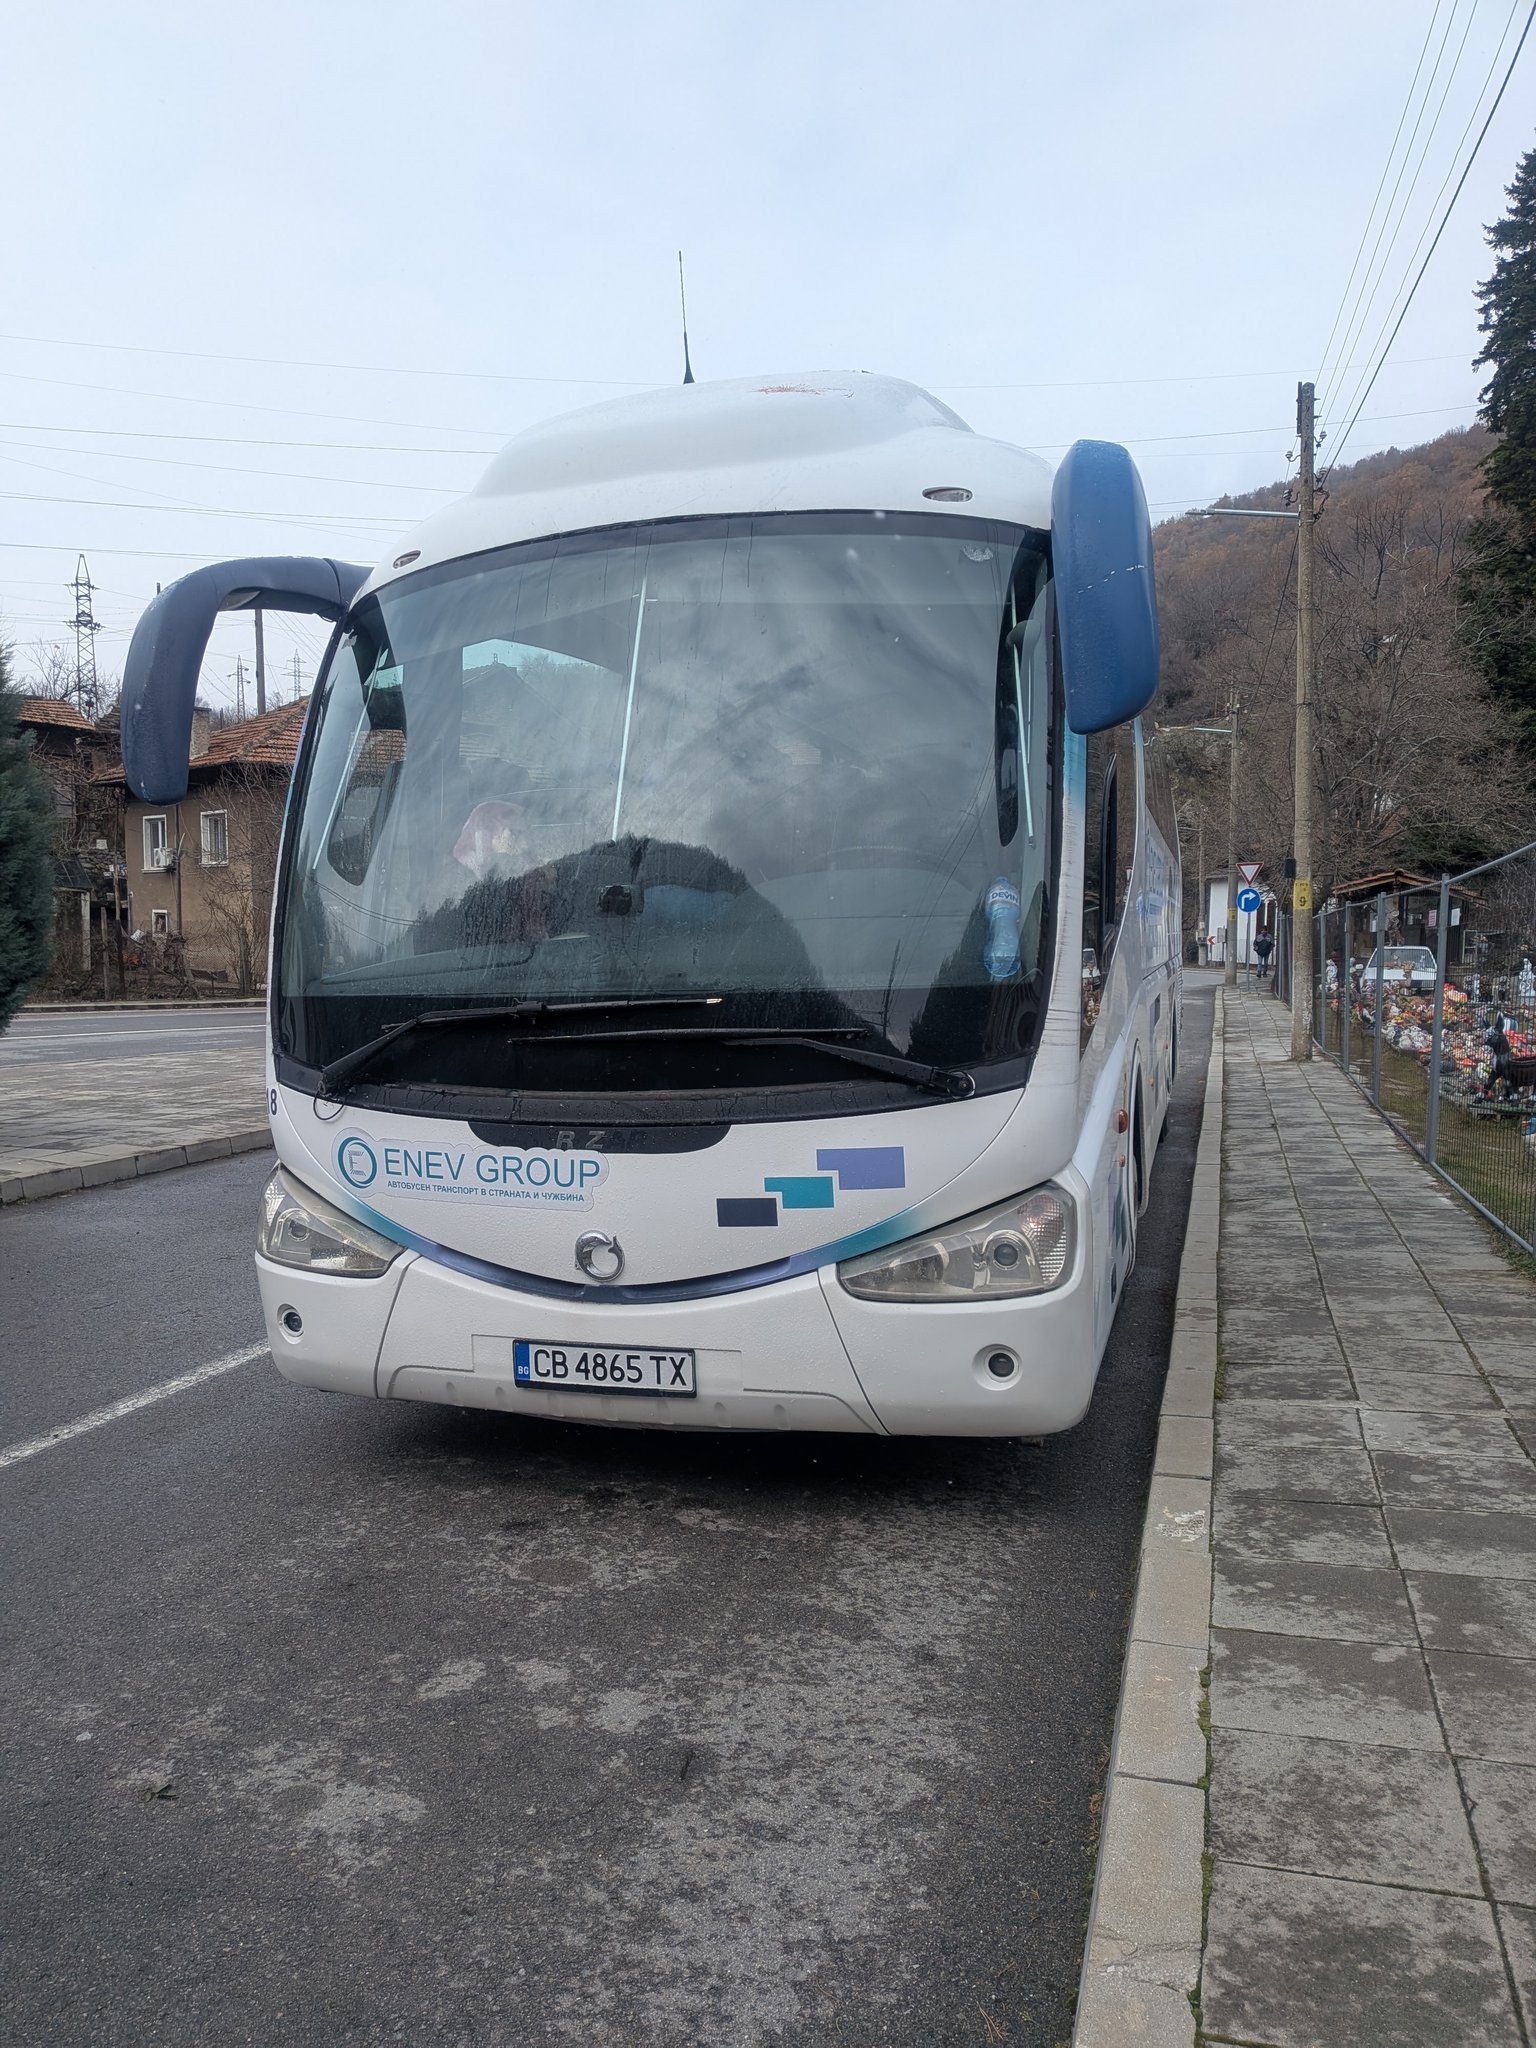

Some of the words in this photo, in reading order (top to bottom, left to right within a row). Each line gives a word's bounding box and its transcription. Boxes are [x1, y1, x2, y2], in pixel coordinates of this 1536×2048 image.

[991, 891, 1018, 902] DEVIN
[384, 1148, 465, 1180] ENEV
[476, 1154, 600, 1188] GROUP
[387, 1180, 431, 1192] АВТОБУСЕН
[432, 1184, 479, 1196] ТРАНСПОРТ
[480, 1188, 487, 1196] В
[488, 1189, 531, 1200] СТРАНАТА
[533, 1191, 540, 1200] И
[541, 1192, 585, 1202] ЧУЖБИНА
[518, 1366, 529, 1375] BG
[534, 1349, 568, 1379] CB
[575, 1352, 643, 1384] 4865
[650, 1356, 687, 1386] TX
